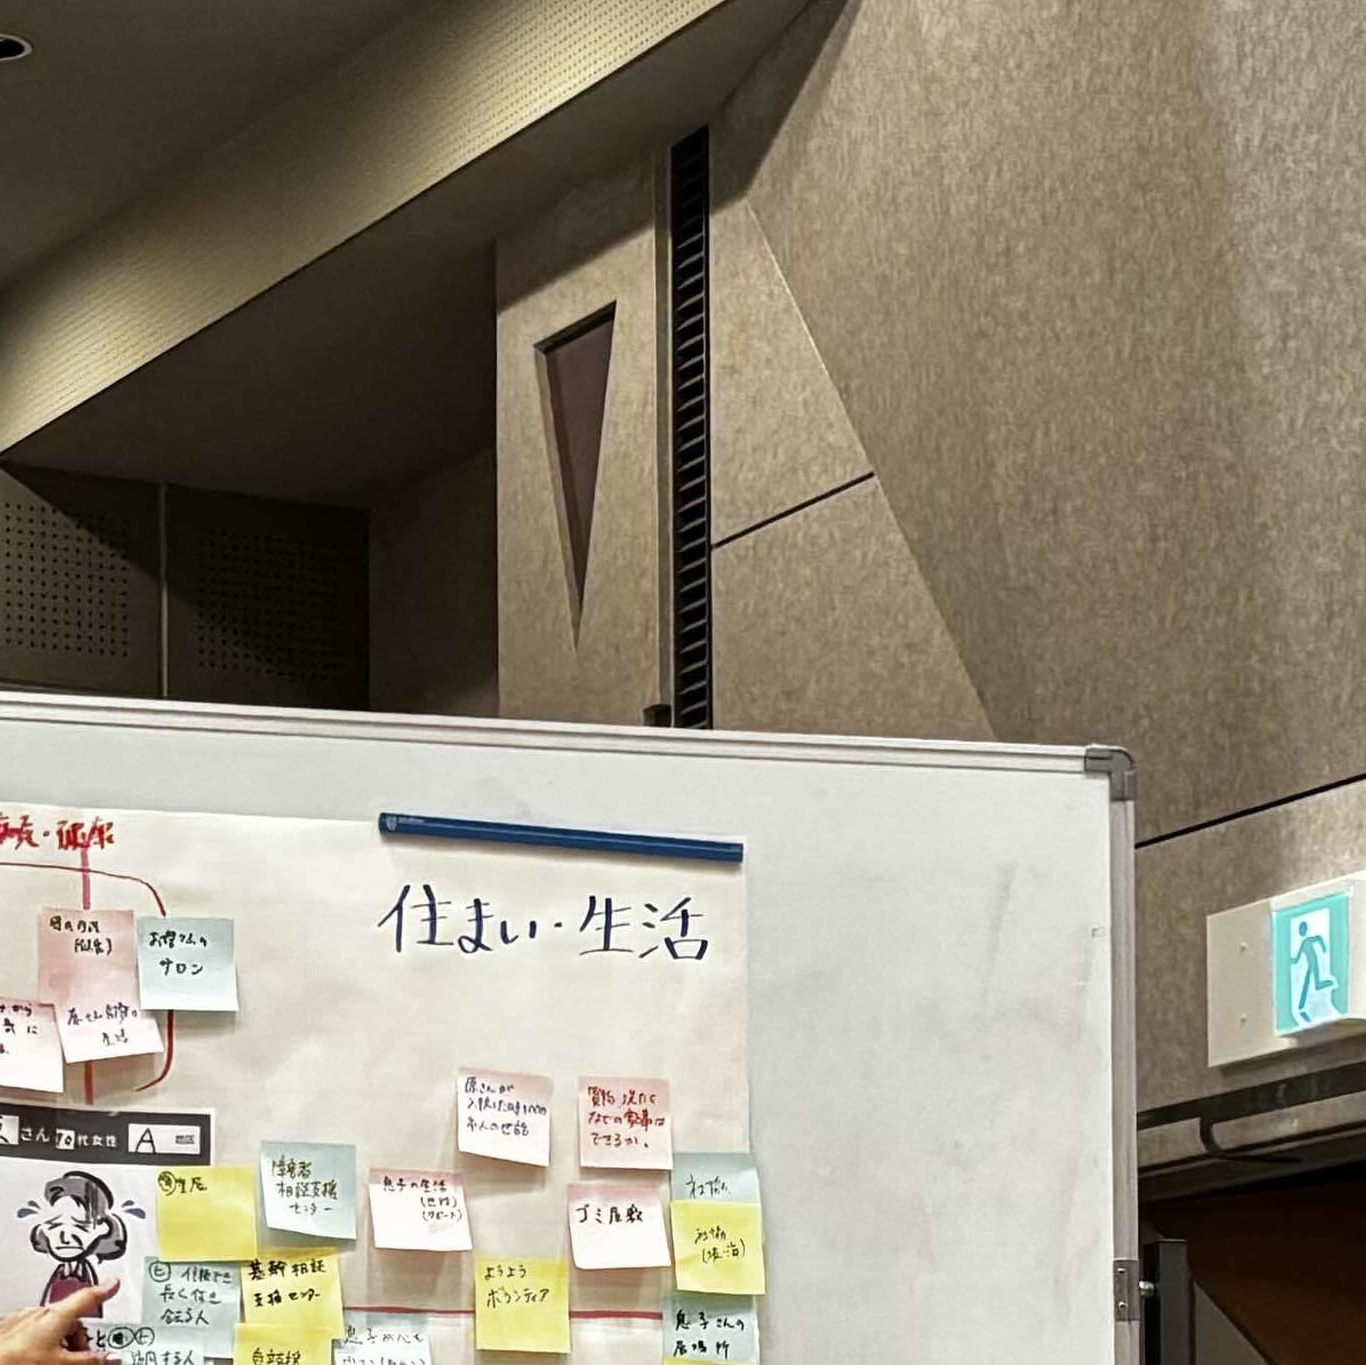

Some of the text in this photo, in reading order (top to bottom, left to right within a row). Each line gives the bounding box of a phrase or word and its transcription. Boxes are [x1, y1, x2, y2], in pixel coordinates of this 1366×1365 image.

[378, 884, 709, 960] 住まい・生活
[136, 1128, 157, 1154] A
